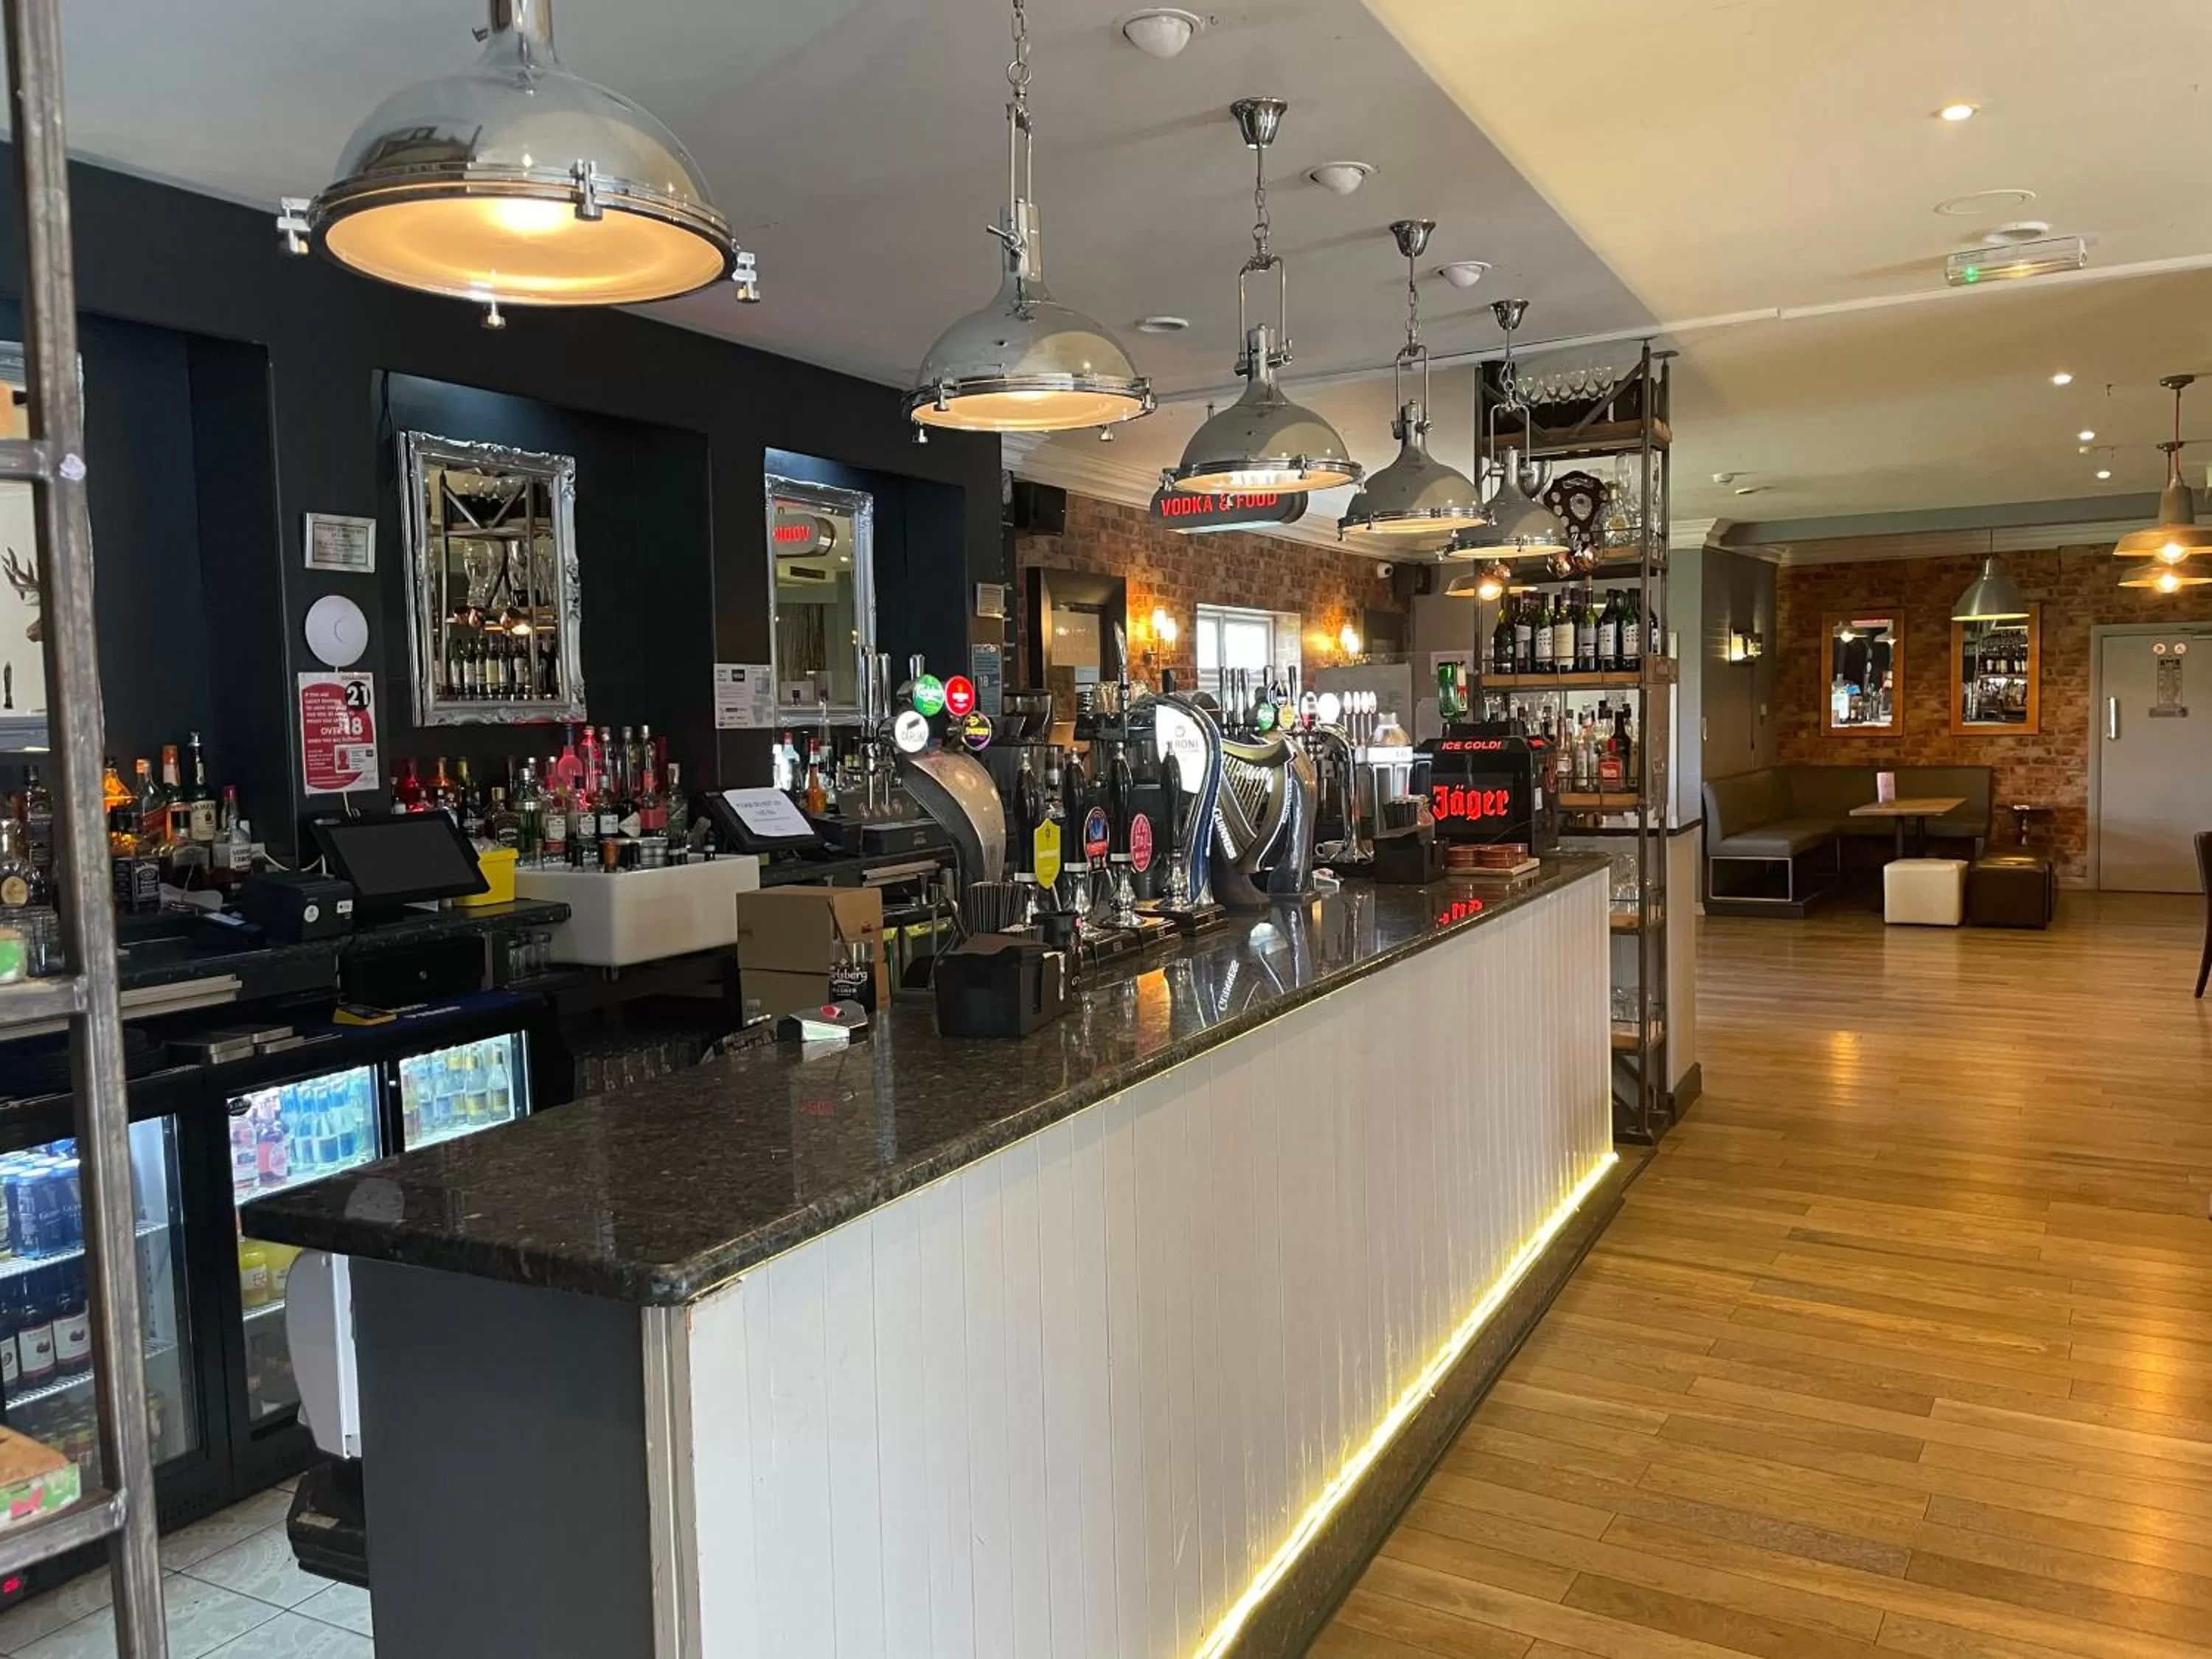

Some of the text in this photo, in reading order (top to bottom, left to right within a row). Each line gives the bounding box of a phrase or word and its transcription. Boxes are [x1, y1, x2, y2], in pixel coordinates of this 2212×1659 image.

[1161, 495, 1213, 516] VODKA
[1237, 493, 1277, 509] FOOD
[978, 675, 989, 686] 18
[347, 685, 369, 706] 21
[321, 715, 363, 736] OVER 18
[1441, 740, 1502, 751] ICE COLD!
[1433, 784, 1509, 821] Jäger
[1212, 807, 1237, 859] GUINNESS
